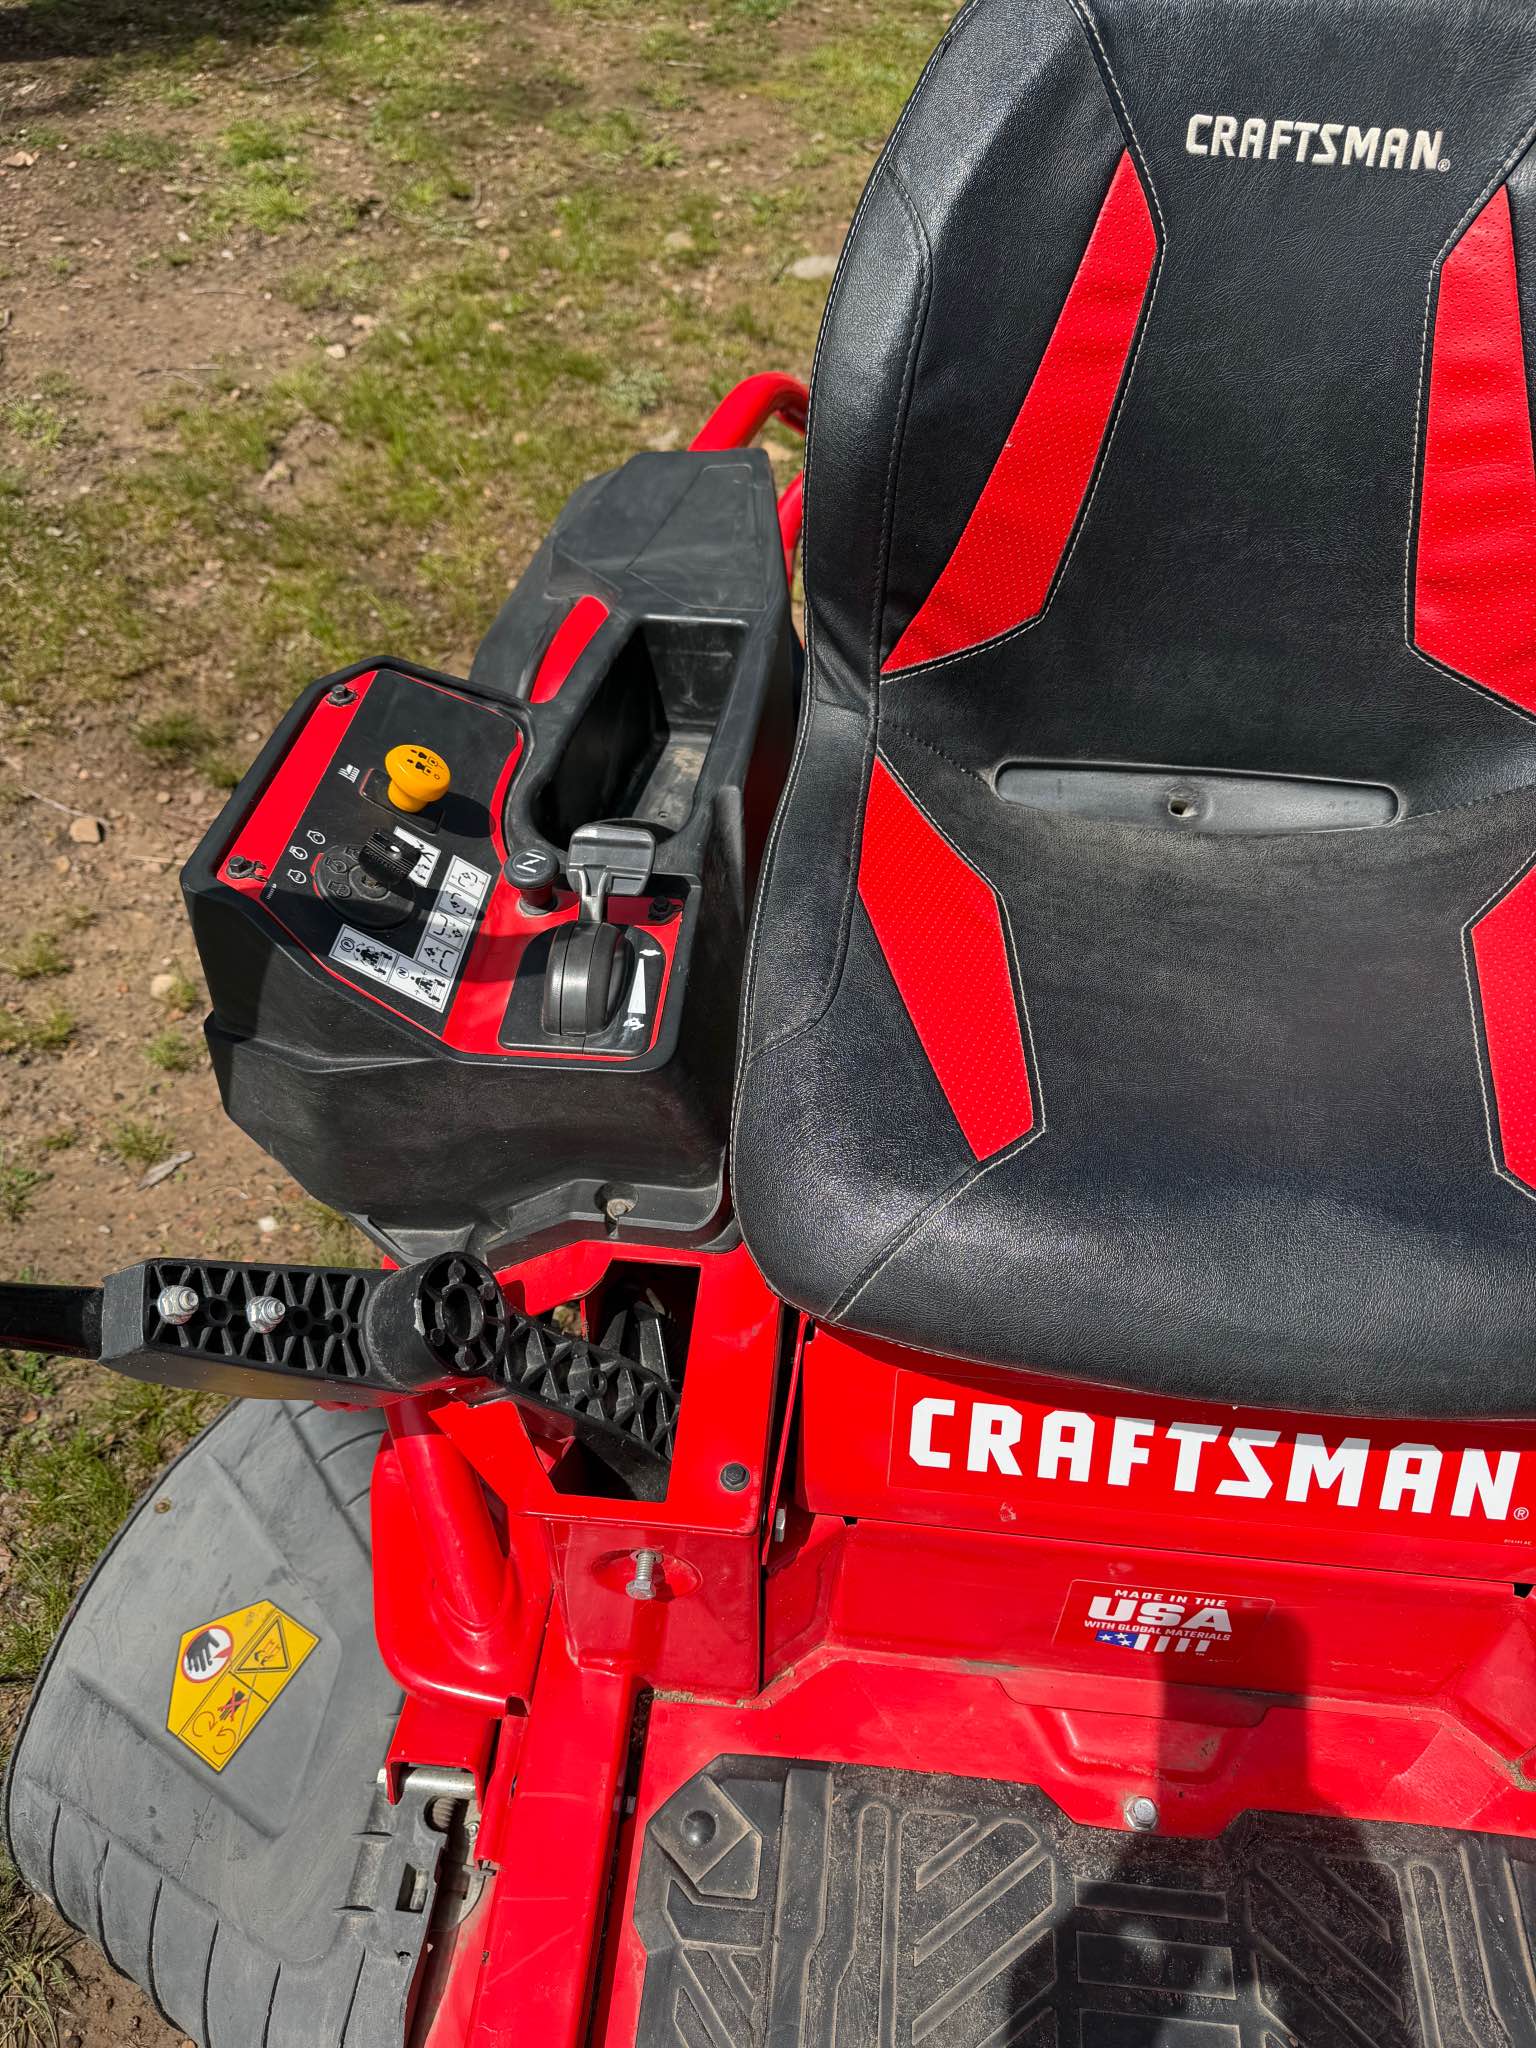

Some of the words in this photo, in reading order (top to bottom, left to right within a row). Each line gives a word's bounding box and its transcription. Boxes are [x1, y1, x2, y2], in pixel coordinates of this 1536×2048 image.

[1114, 1589, 1164, 1601] MADE
[1169, 1594, 1188, 1604] IN
[1195, 1597, 1228, 1608] THE
[1087, 1595, 1233, 1633] USA
[1084, 1620, 1116, 1630] WITH
[1118, 1623, 1161, 1635] GLOBAL
[1164, 1629, 1231, 1642] MATERIALS
